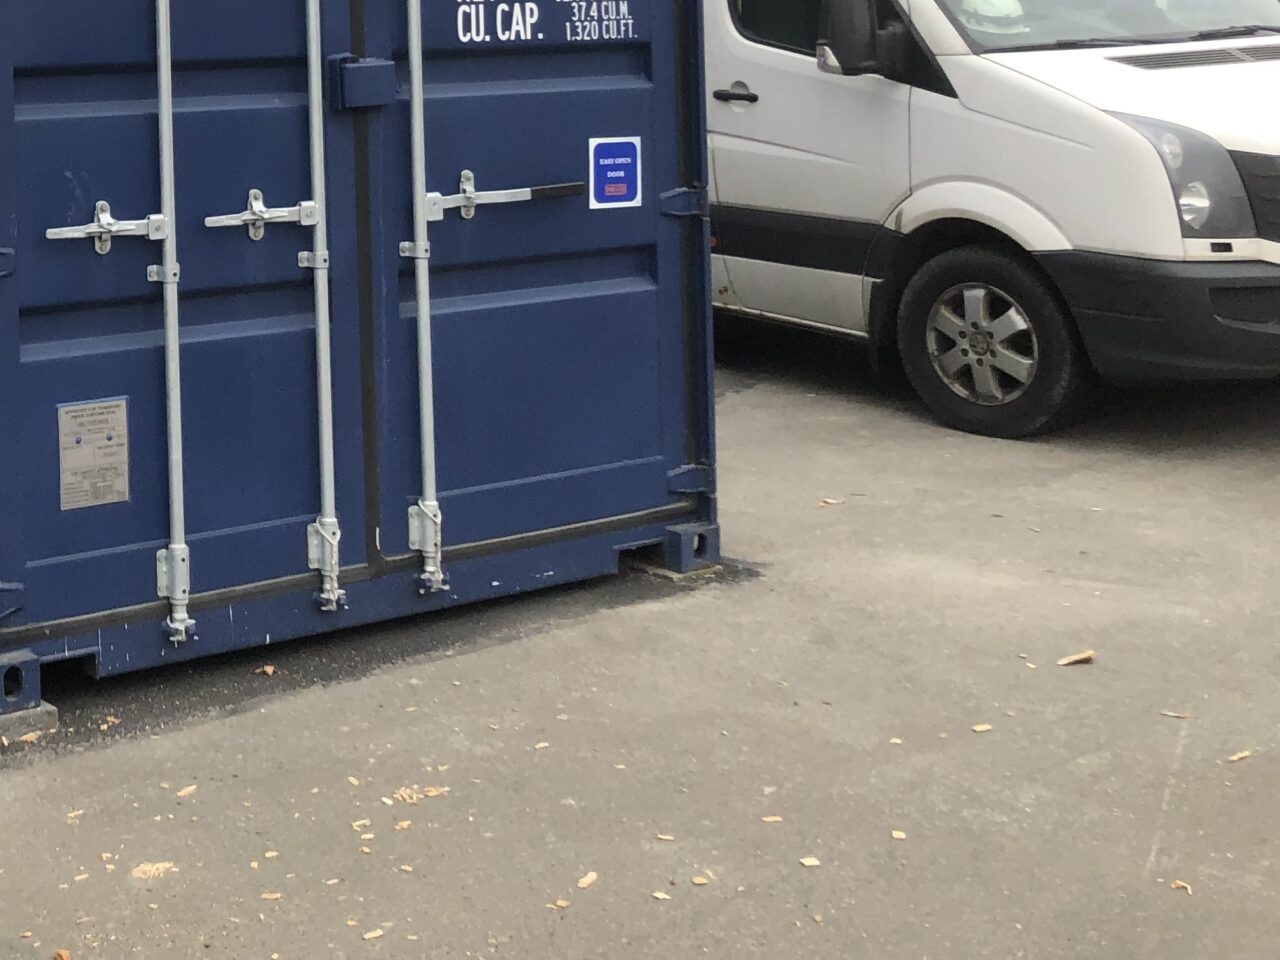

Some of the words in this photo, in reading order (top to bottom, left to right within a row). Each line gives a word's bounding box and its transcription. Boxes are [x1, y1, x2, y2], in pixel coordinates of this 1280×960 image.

[457, 3, 491, 43] CU.
[496, 2, 544, 41] CAP.
[571, 2, 598, 21] 37.4
